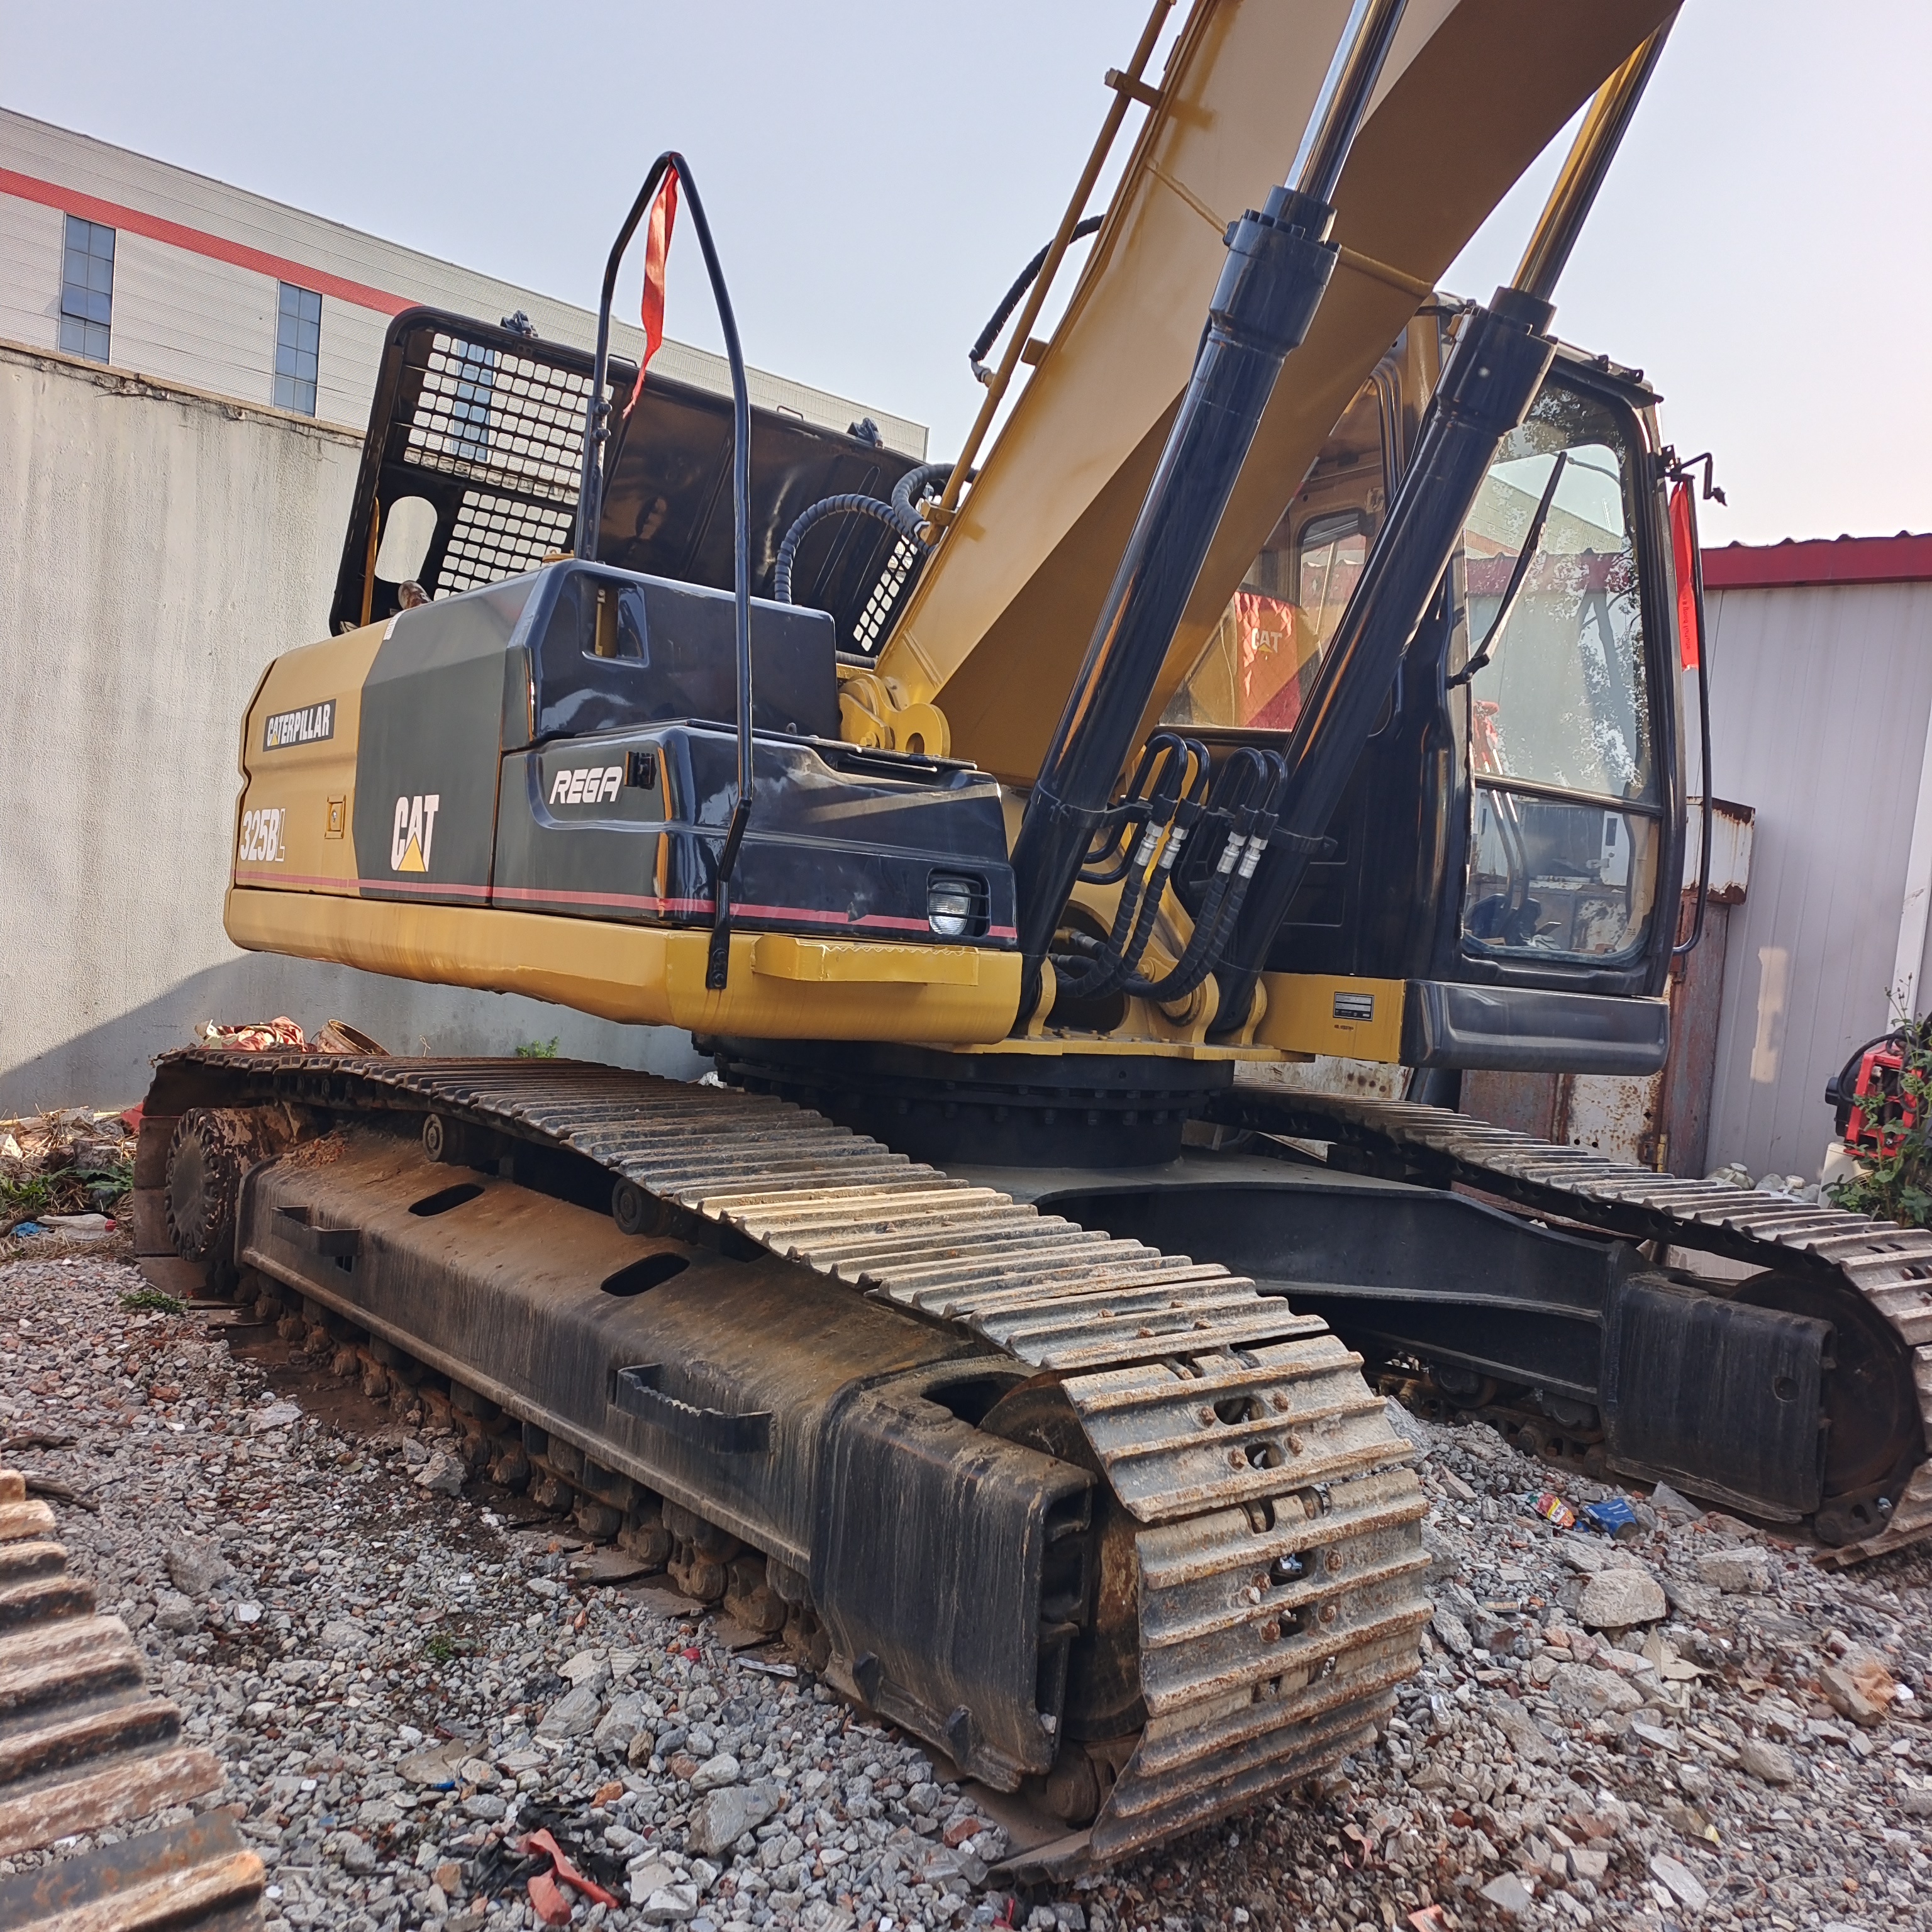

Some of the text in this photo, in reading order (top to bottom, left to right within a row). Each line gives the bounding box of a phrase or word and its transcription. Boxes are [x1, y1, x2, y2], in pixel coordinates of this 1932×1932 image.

[1252, 628, 1282, 653] CAT
[267, 704, 331, 747] CATERPILLAR
[549, 766, 623, 804] REGA
[391, 794, 440, 872] CAT
